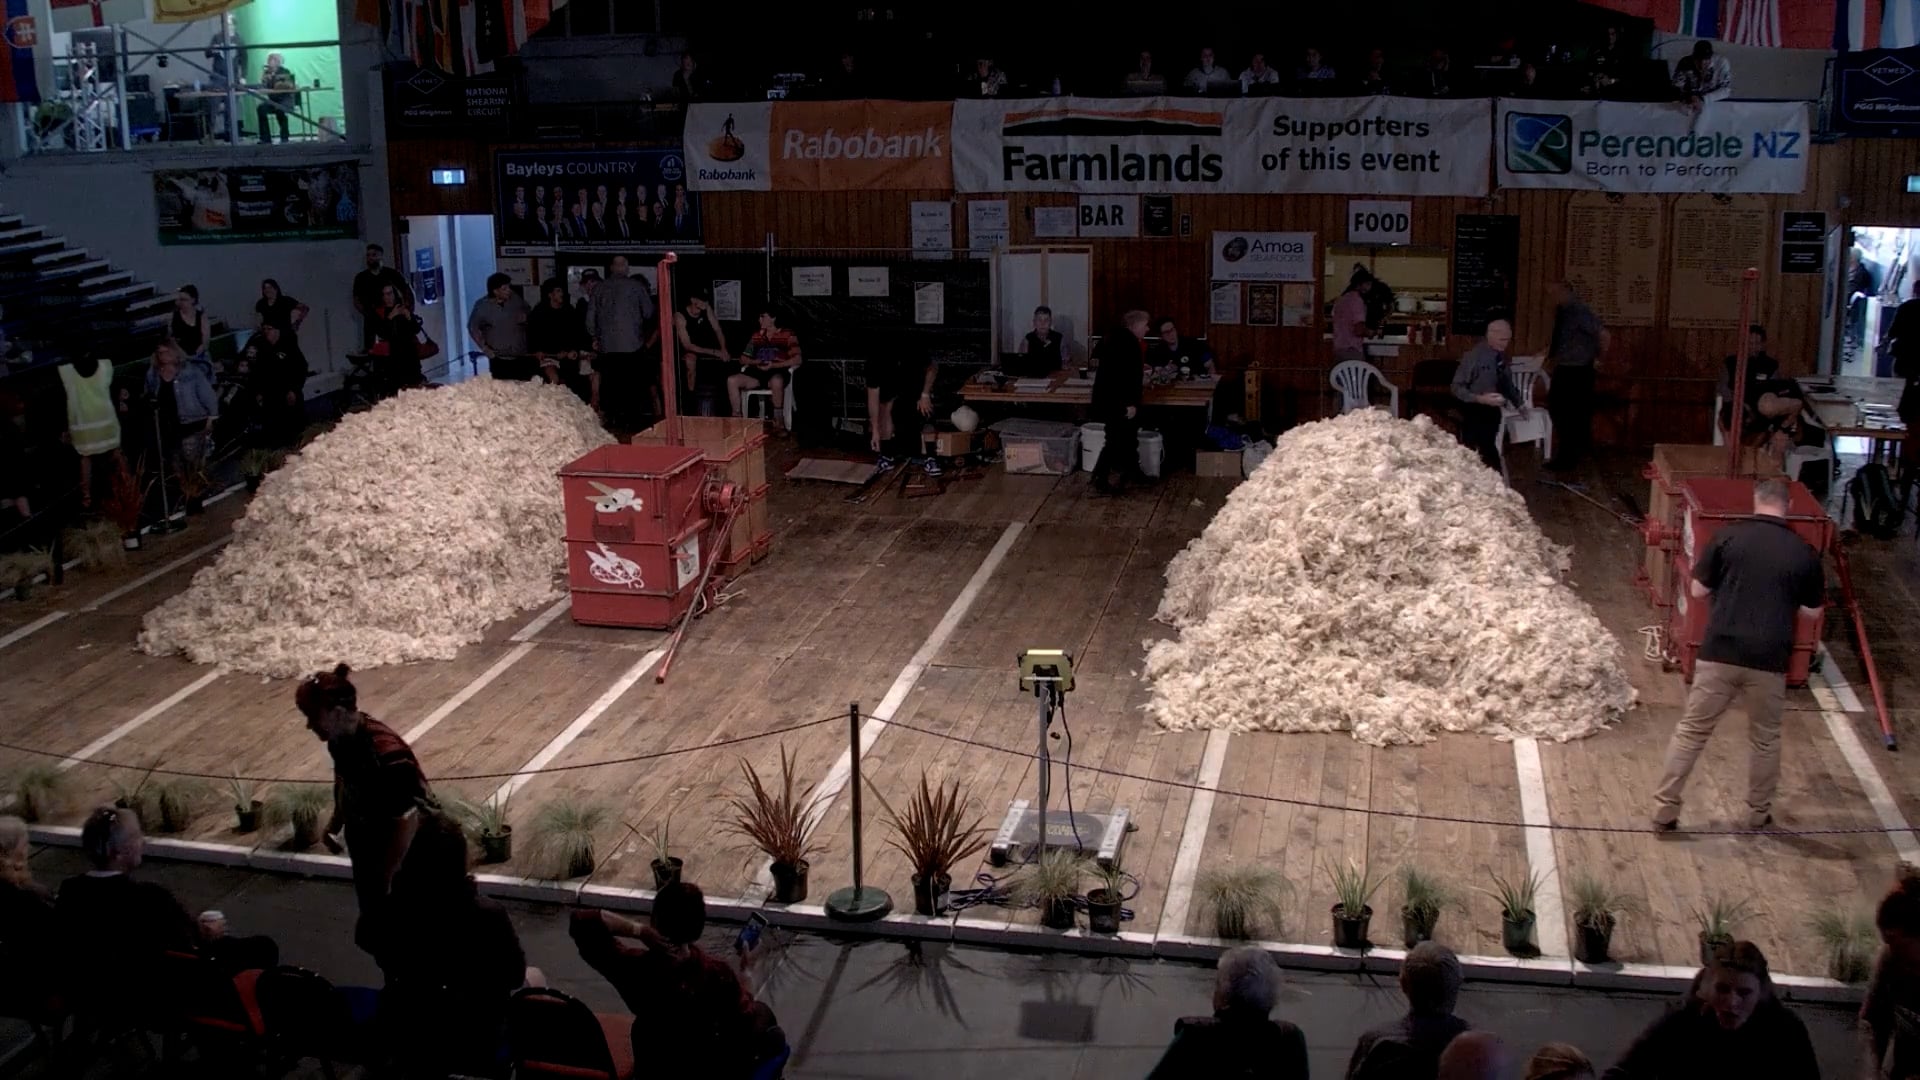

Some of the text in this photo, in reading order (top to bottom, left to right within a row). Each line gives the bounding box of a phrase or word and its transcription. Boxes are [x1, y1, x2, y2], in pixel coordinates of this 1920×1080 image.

[466, 107, 502, 116] CIRCUIT
[1273, 115, 1430, 141] Supporters
[782, 127, 943, 160] Rabobank
[1578, 129, 1801, 159] Perendale NZ
[505, 161, 638, 178] Bayleys COUNTRY
[1002, 144, 1223, 182] Farmlands
[1262, 147, 1441, 172] of this event
[1586, 162, 1739, 177] Born to Perform
[698, 168, 756, 181] Rabobank
[1080, 204, 1125, 226] BAR
[1353, 212, 1409, 233] FOOD
[1250, 239, 1305, 253] Amoa
[1250, 254, 1305, 262] SEAFOODS
